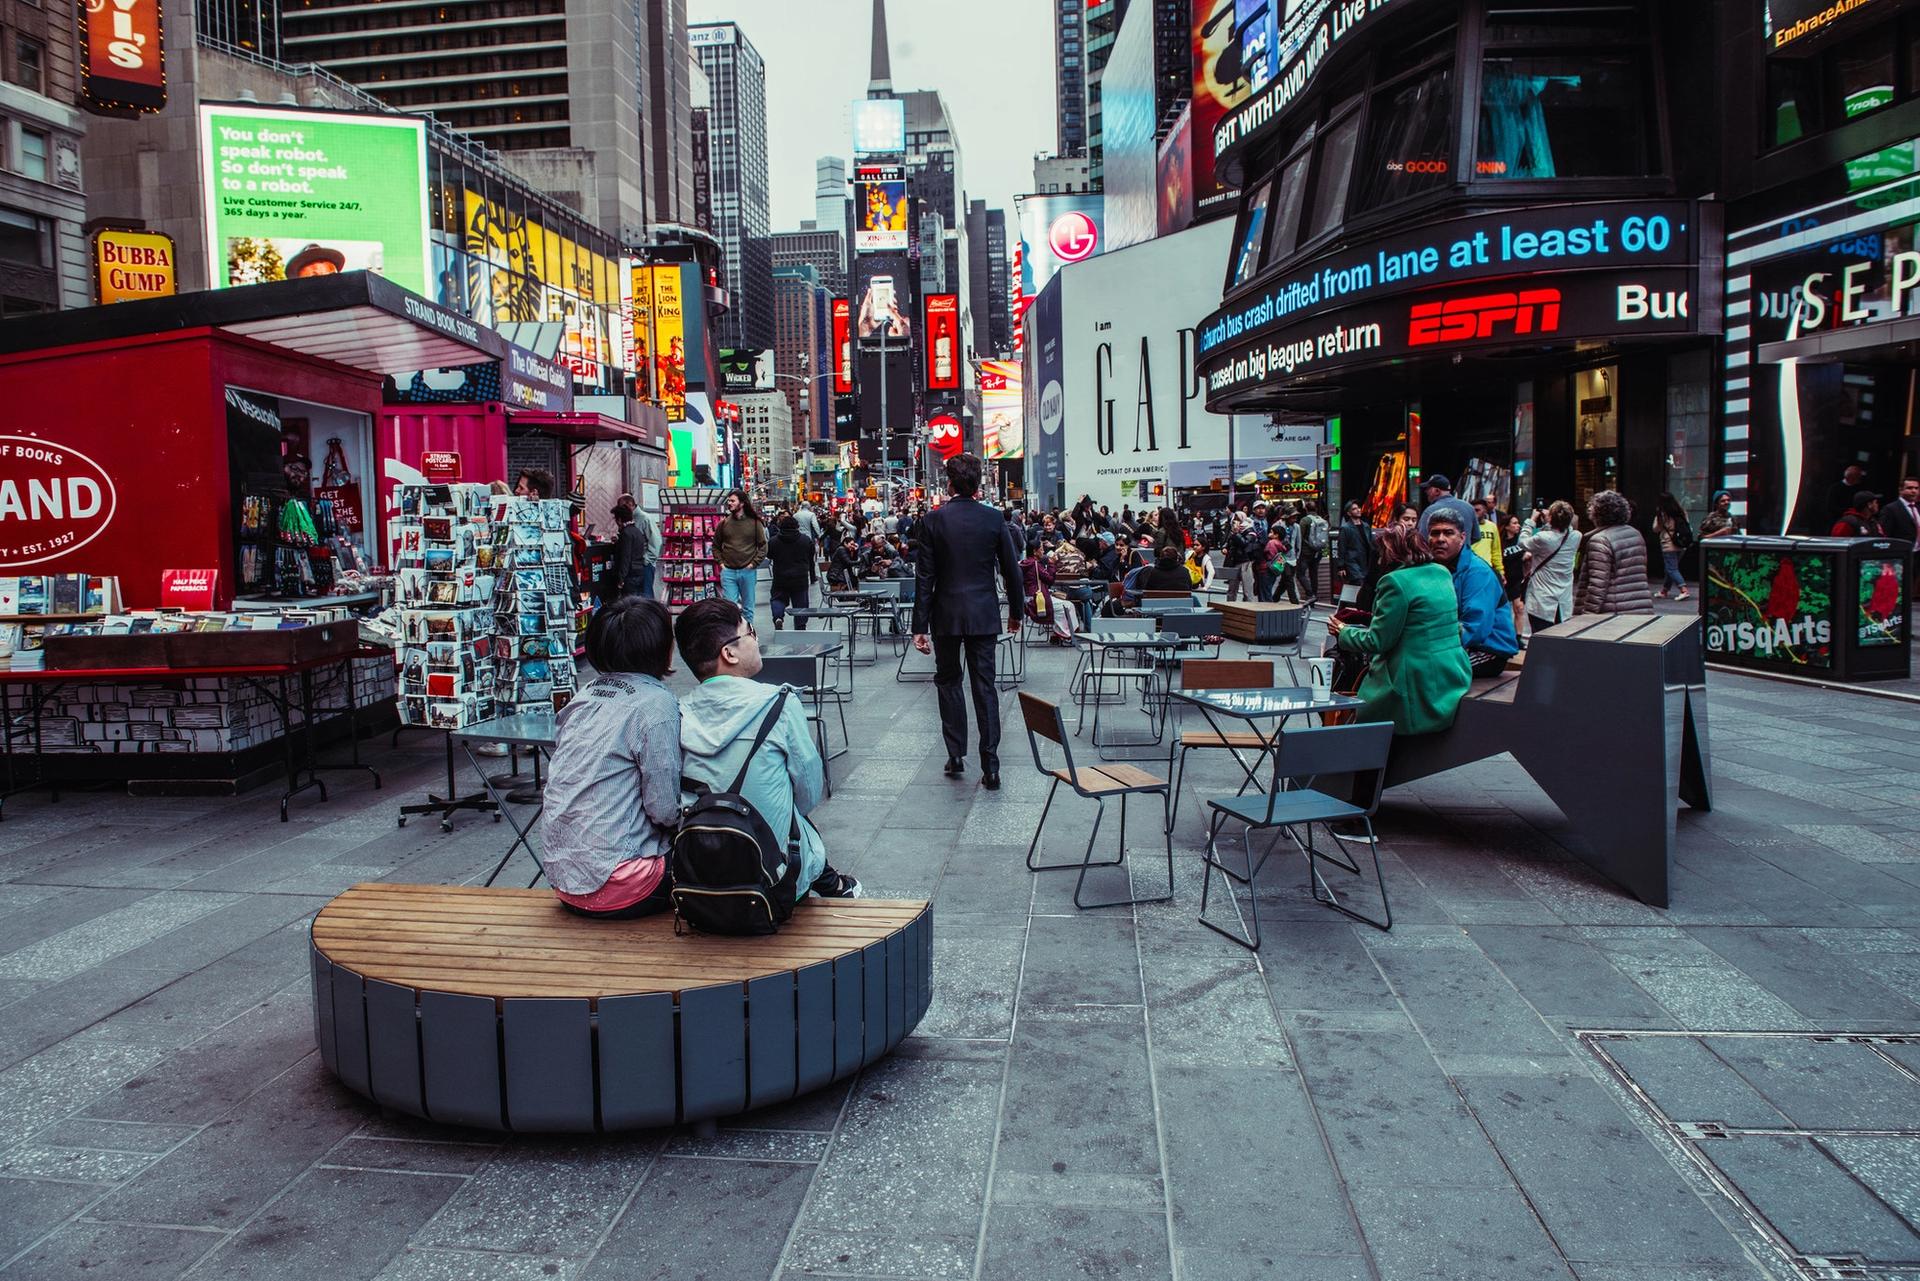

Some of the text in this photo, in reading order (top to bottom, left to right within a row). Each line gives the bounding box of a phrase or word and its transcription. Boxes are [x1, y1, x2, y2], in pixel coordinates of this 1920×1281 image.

[1239, 92, 1273, 136] WITH
[1275, 60, 1306, 112] DAVID
[1306, 24, 1330, 79] MUIR
[1333, 0, 1366, 41] Live
[219, 127, 304, 144] You don't
[220, 145, 328, 162] speak robot.
[221, 160, 348, 180] So don't speak
[692, 130, 707, 204] TIMES
[1387, 161, 1403, 170] abc
[1406, 161, 1447, 173] GOOD
[222, 177, 314, 194] to a robot.
[223, 197, 362, 212] Live Customer Service 24/7,
[224, 208, 243, 216] 365
[246, 209, 270, 219] days
[282, 211, 307, 220] year.
[103, 241, 169, 267] BUBBA
[109, 268, 166, 292] GUMP
[1204, 215, 1670, 351] church bus crash drifted from lane at least 60
[659, 294, 677, 304] LION
[404, 296, 479, 343] STRAND BOOK STORE
[658, 306, 680, 318] KING
[1408, 288, 1561, 346] ESPN
[1095, 321, 1112, 331] I am
[1236, 360, 1247, 381] on
[1249, 349, 1266, 380] big
[1268, 339, 1314, 373] league
[1318, 323, 1380, 358] return
[511, 349, 525, 373] The
[526, 356, 549, 382] Official
[549, 366, 566, 389] Guide
[1096, 327, 1200, 456] GAP
[0, 445, 63, 465] F BOOKS
[320, 490, 339, 499] GET
[1282, 483, 1315, 492] GYRO
[22, 543, 46, 555] EST.
[49, 531, 75, 548] 1927
[1706, 615, 1831, 654] @TSqArts
[1859, 615, 1902, 638] @TSqArts
